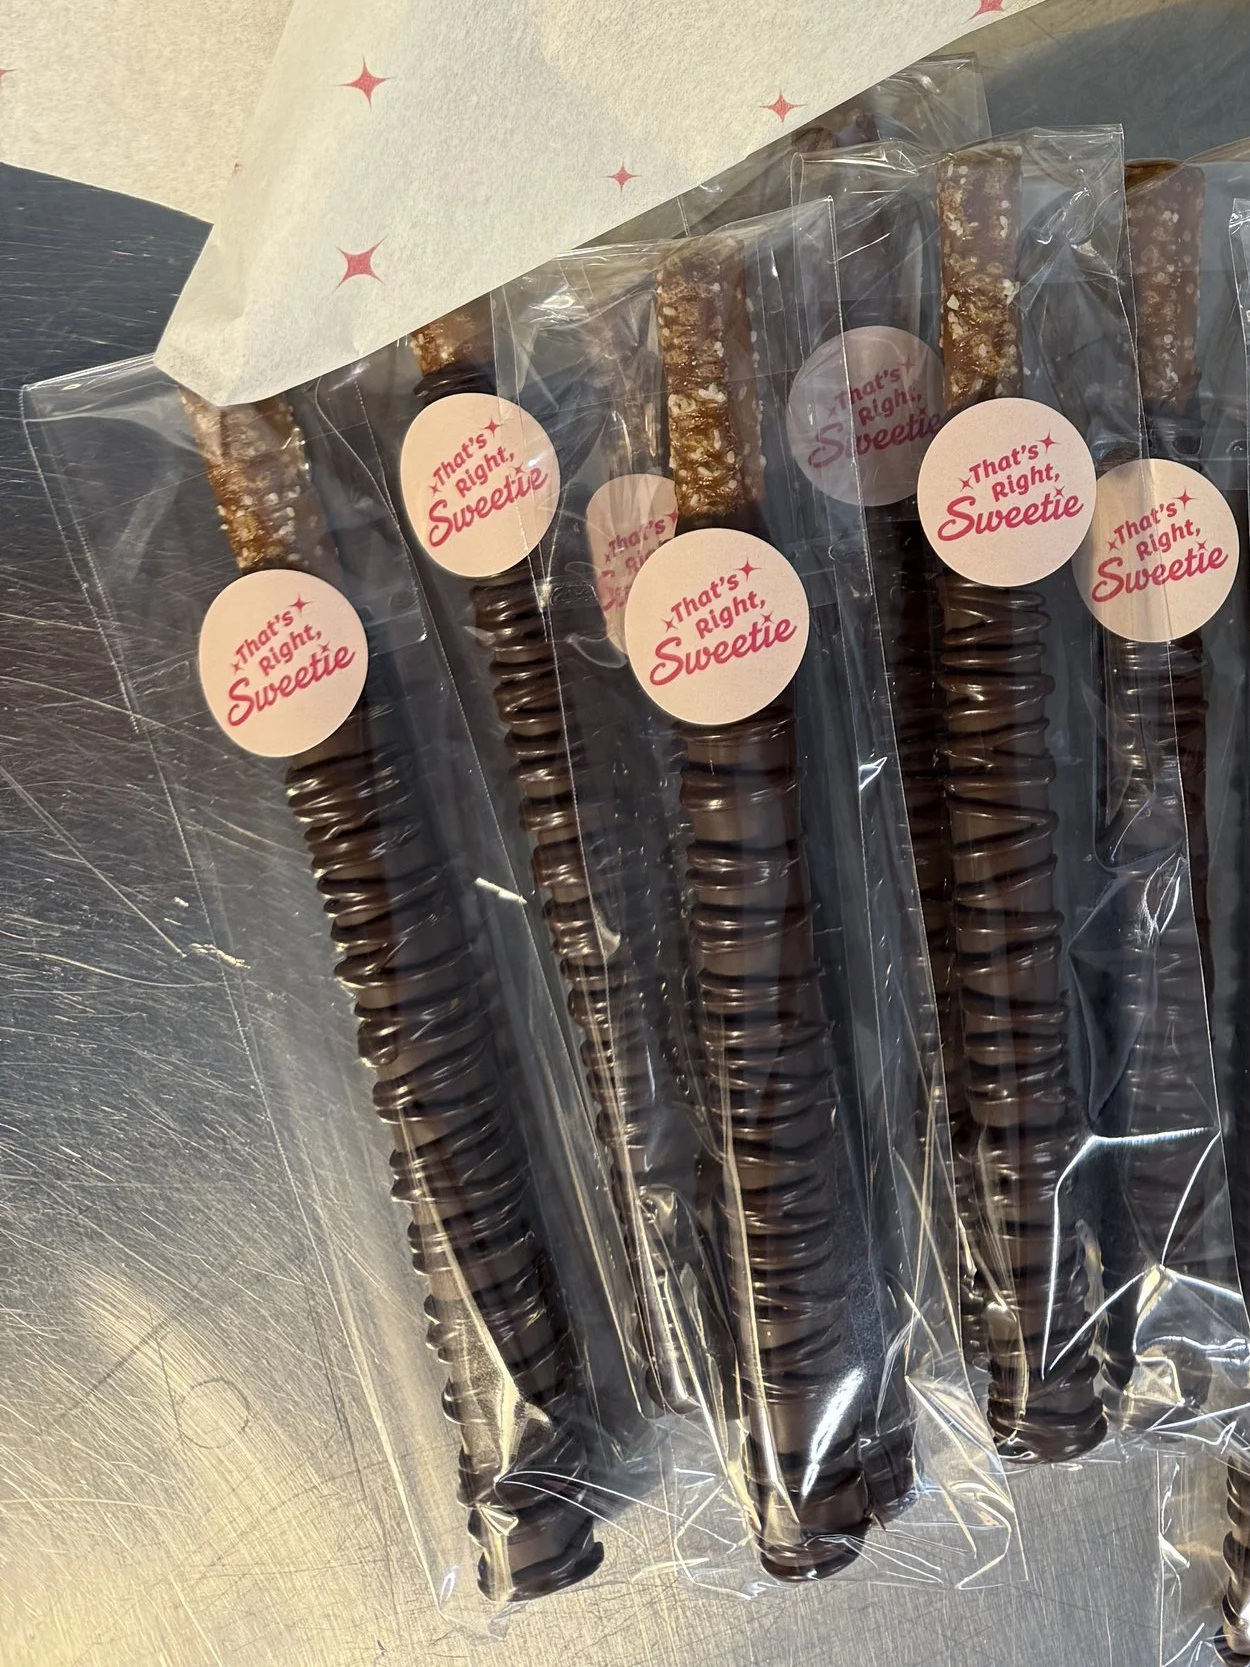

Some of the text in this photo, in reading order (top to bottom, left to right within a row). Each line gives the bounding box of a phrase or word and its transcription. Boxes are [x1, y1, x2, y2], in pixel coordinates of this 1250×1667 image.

[835, 367, 900, 416] That's
[432, 431, 487, 486] That's
[456, 445, 515, 497] Right,
[969, 444, 1039, 484] That's
[991, 464, 1061, 502] Right,
[429, 465, 548, 548] Sweetie
[937, 492, 1084, 542] Sweetie
[1113, 502, 1178, 544] That's
[1136, 519, 1201, 561] Right,
[671, 574, 739, 623] That's
[1091, 545, 1228, 602] Sweetie
[235, 608, 294, 665] That's
[696, 591, 766, 639] Right,
[259, 623, 322, 675] Right,
[649, 617, 797, 686] Sweetie
[227, 645, 356, 727] Sweetie
